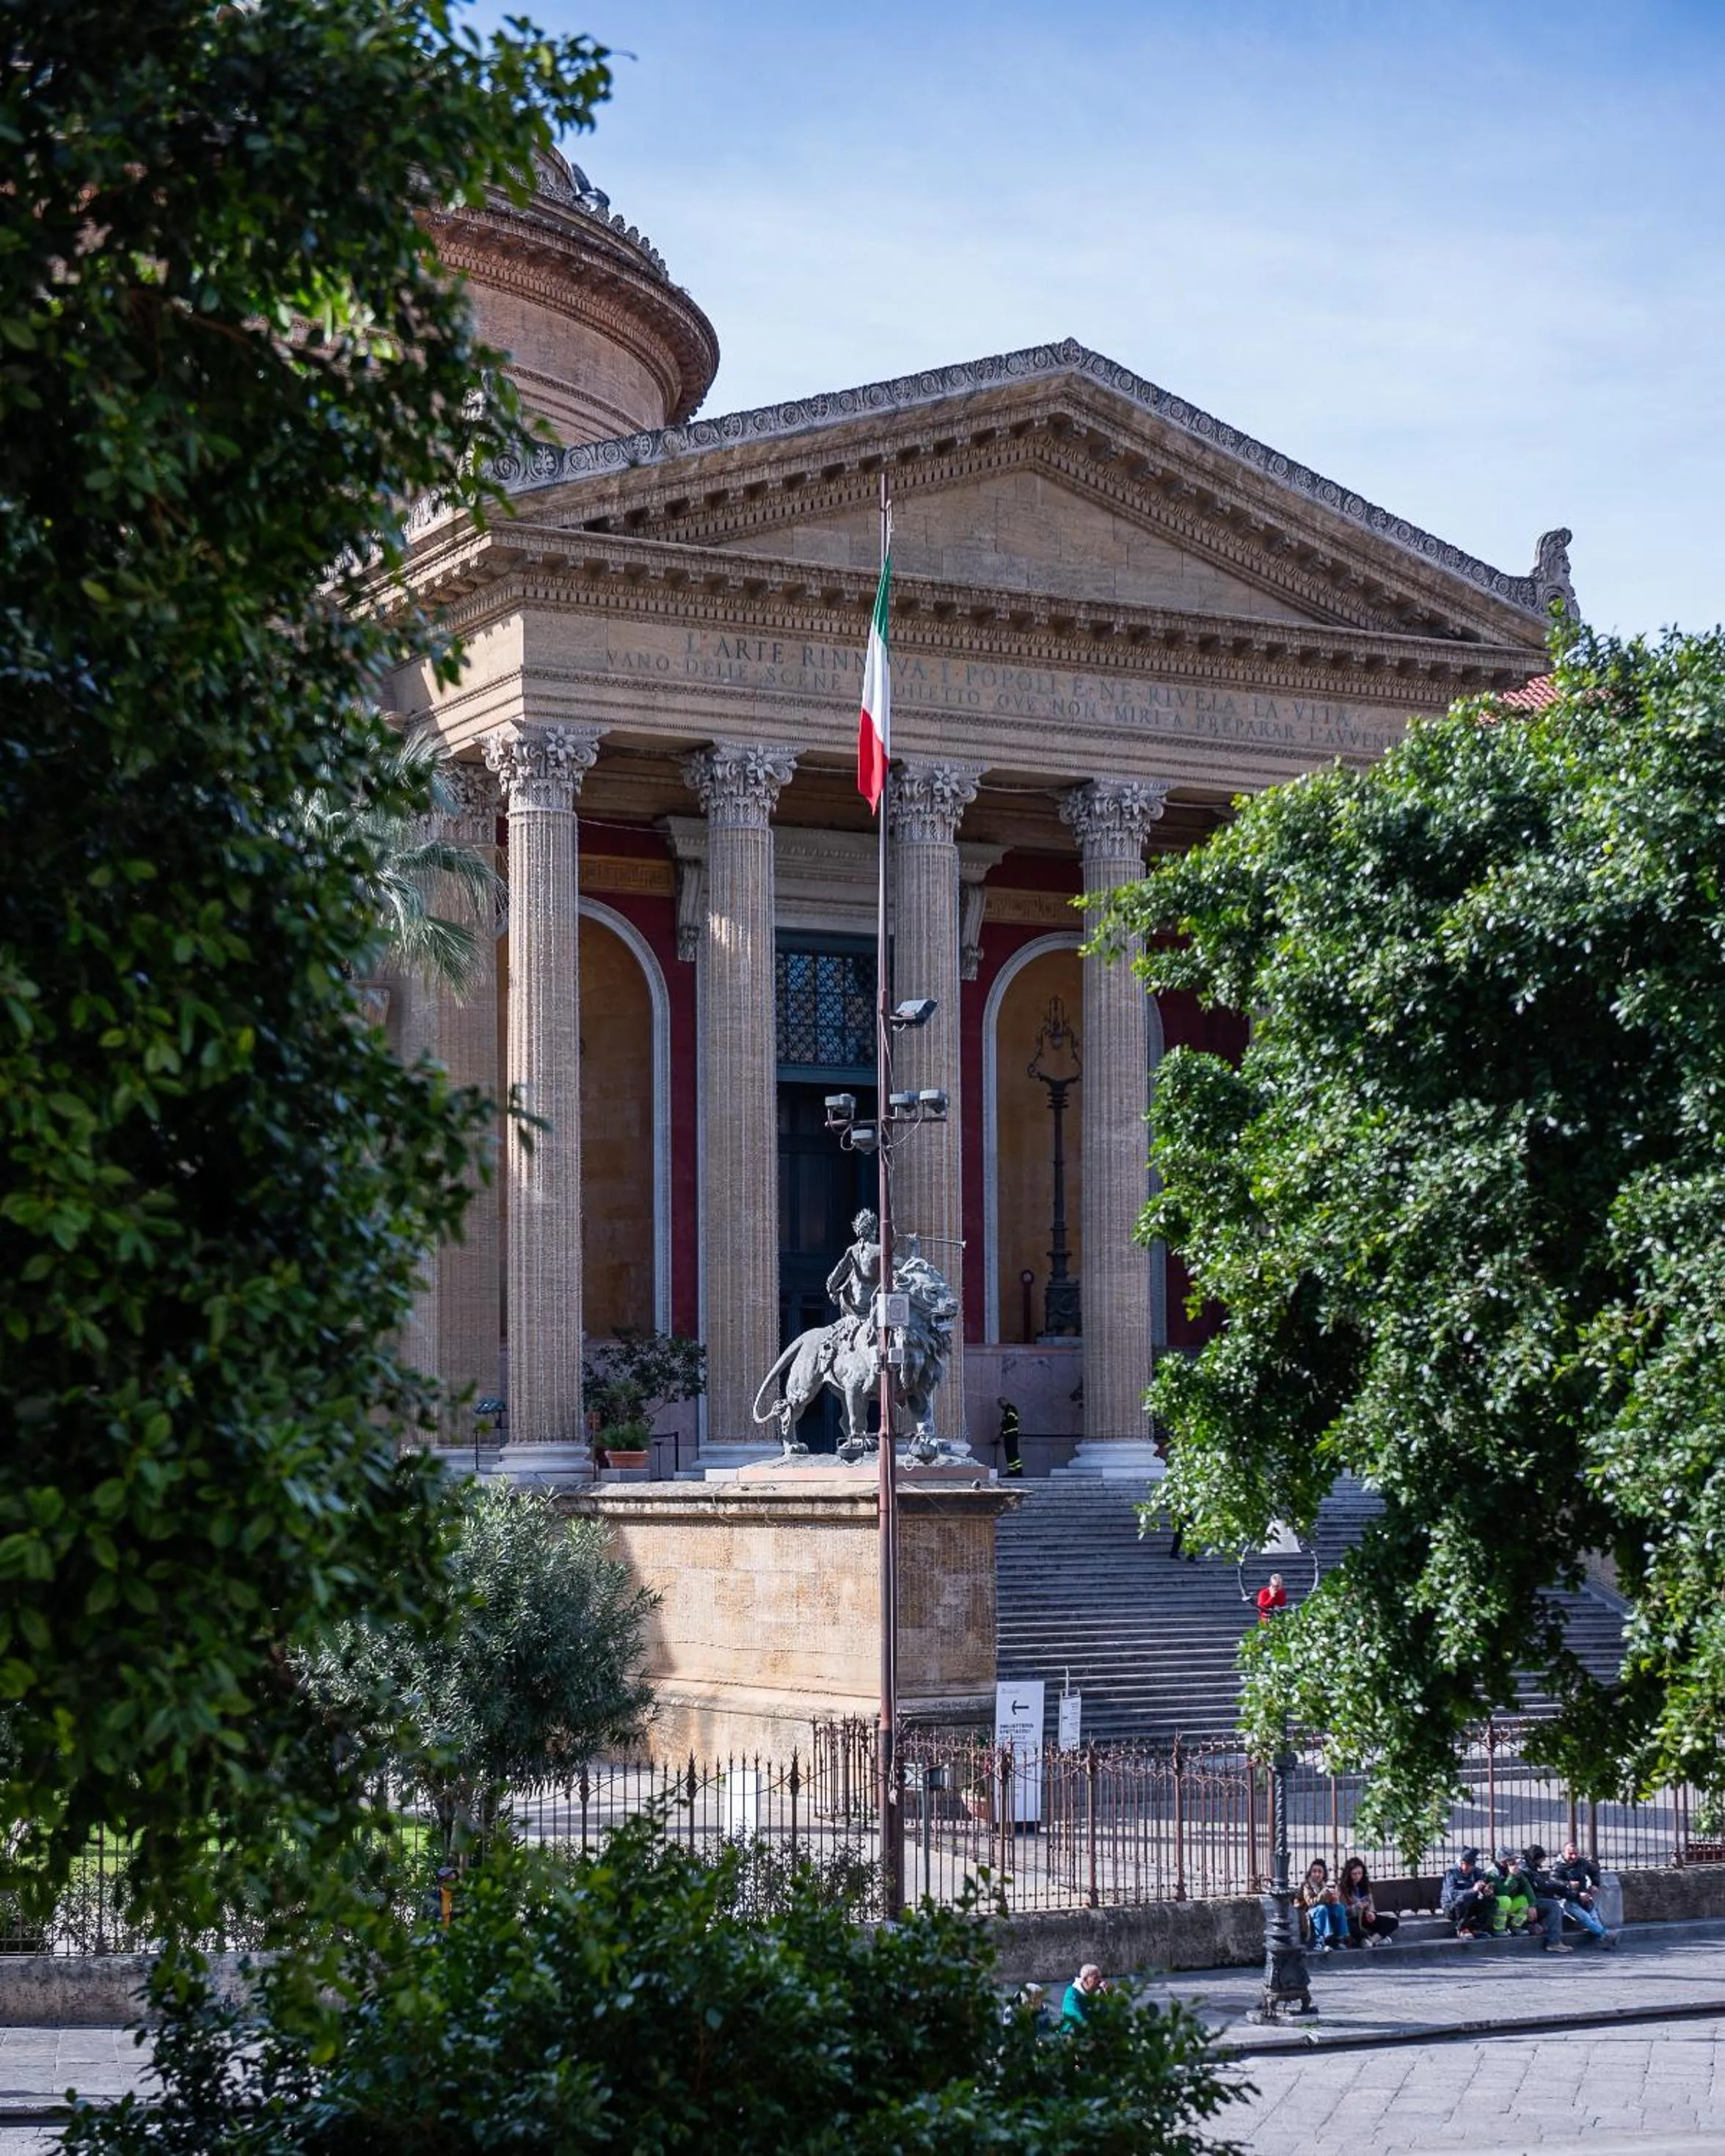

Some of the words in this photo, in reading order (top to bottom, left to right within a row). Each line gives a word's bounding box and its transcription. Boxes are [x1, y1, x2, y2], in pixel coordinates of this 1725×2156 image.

[606, 648, 670, 673] VANO
[759, 665, 841, 691] SCENE
[996, 692, 1035, 712] OVE
[1052, 696, 1096, 719] NON
[1115, 705, 1160, 726] MIRI
[1196, 714, 1296, 739] PREPARAR
[801, 644, 927, 681] RINNVA
[965, 662, 1056, 694] POPOLI
[1099, 676, 1132, 704] NE
[1149, 685, 1236, 715] RIVELA
[1252, 698, 1277, 720] LA
[1293, 699, 1349, 727] VITA
